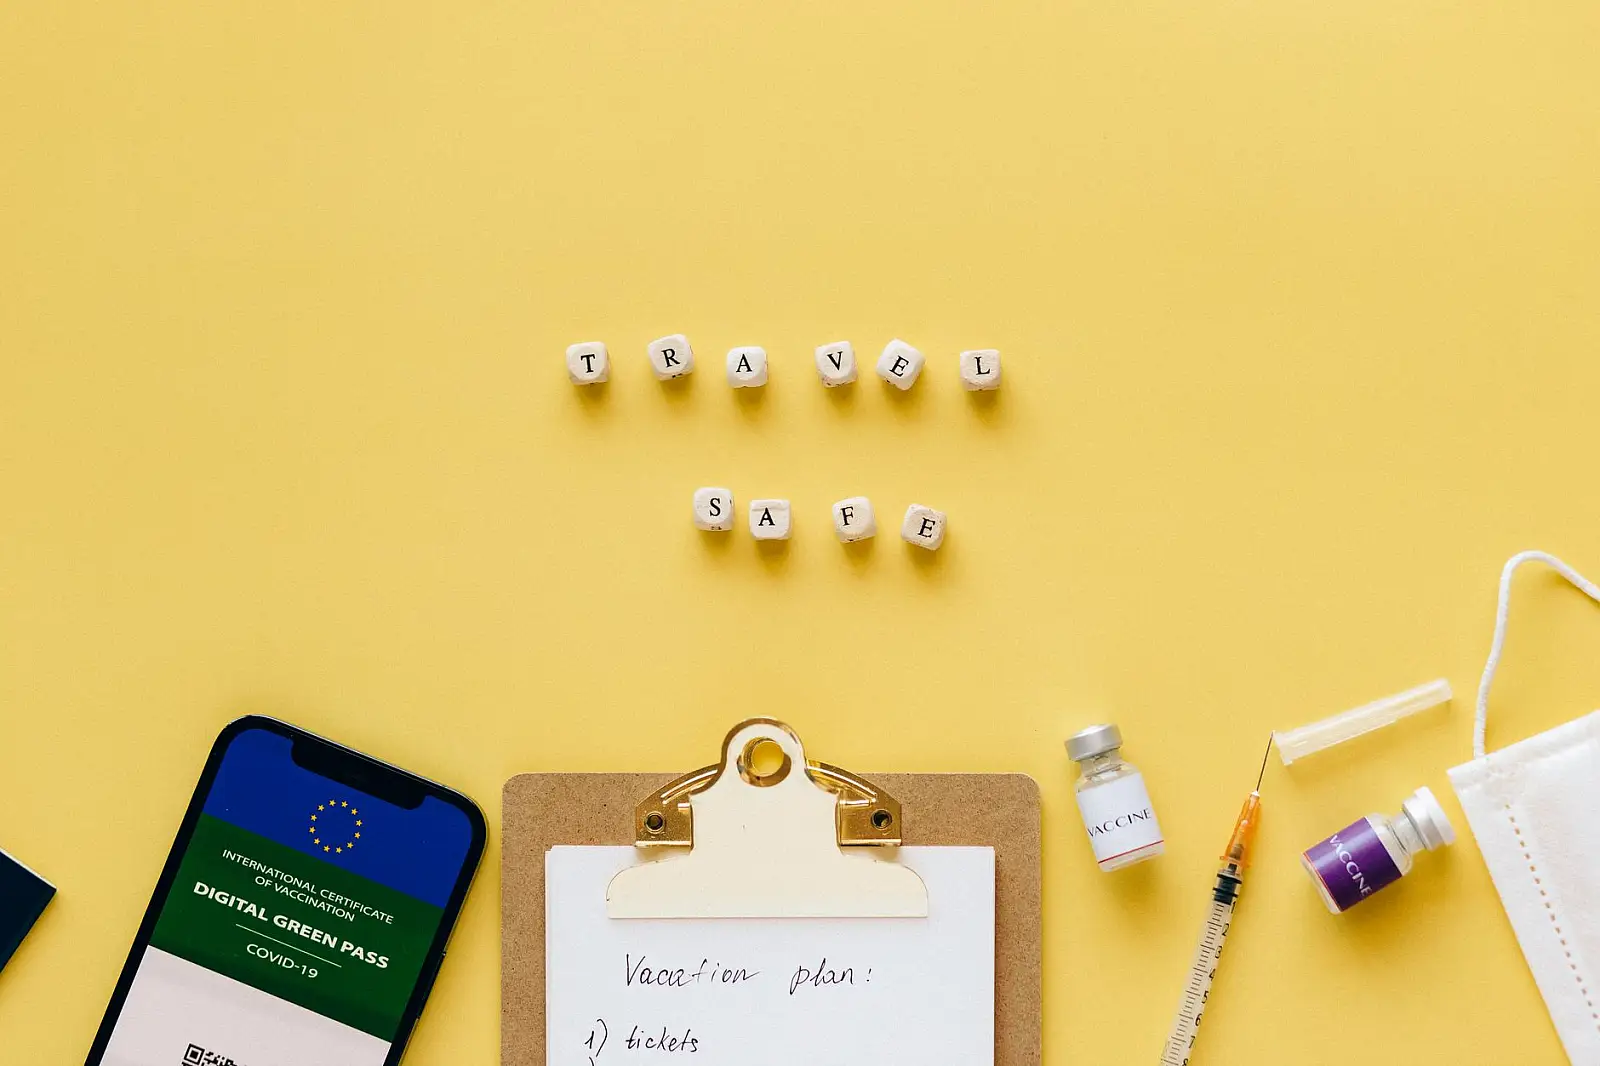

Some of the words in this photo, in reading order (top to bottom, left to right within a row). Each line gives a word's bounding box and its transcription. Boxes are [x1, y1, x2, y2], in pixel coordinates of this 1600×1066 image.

[580, 347, 992, 377] TRAVEL
[708, 497, 936, 539] SAFE
[1087, 808, 1151, 837] VACCINE
[1329, 834, 1373, 896] VACCINE
[222, 849, 317, 895] INTERNATIONAL
[320, 888, 394, 924] CERTIFICATE
[254, 876, 273, 889] OF
[274, 882, 355, 922] VACCINATION
[193, 881, 268, 921] DIGITAL
[273, 914, 338, 948] GREEN
[340, 940, 390, 968] PASS
[1222, 923, 1230, 937] 2
[246, 943, 319, 979] COVID-19
[625, 953, 760, 987] Vacation
[1201, 990, 1209, 1004] 5
[1195, 1013, 1202, 1027] 6
[625, 1025, 699, 1053] tickets
[1188, 1035, 1196, 1049] 7
